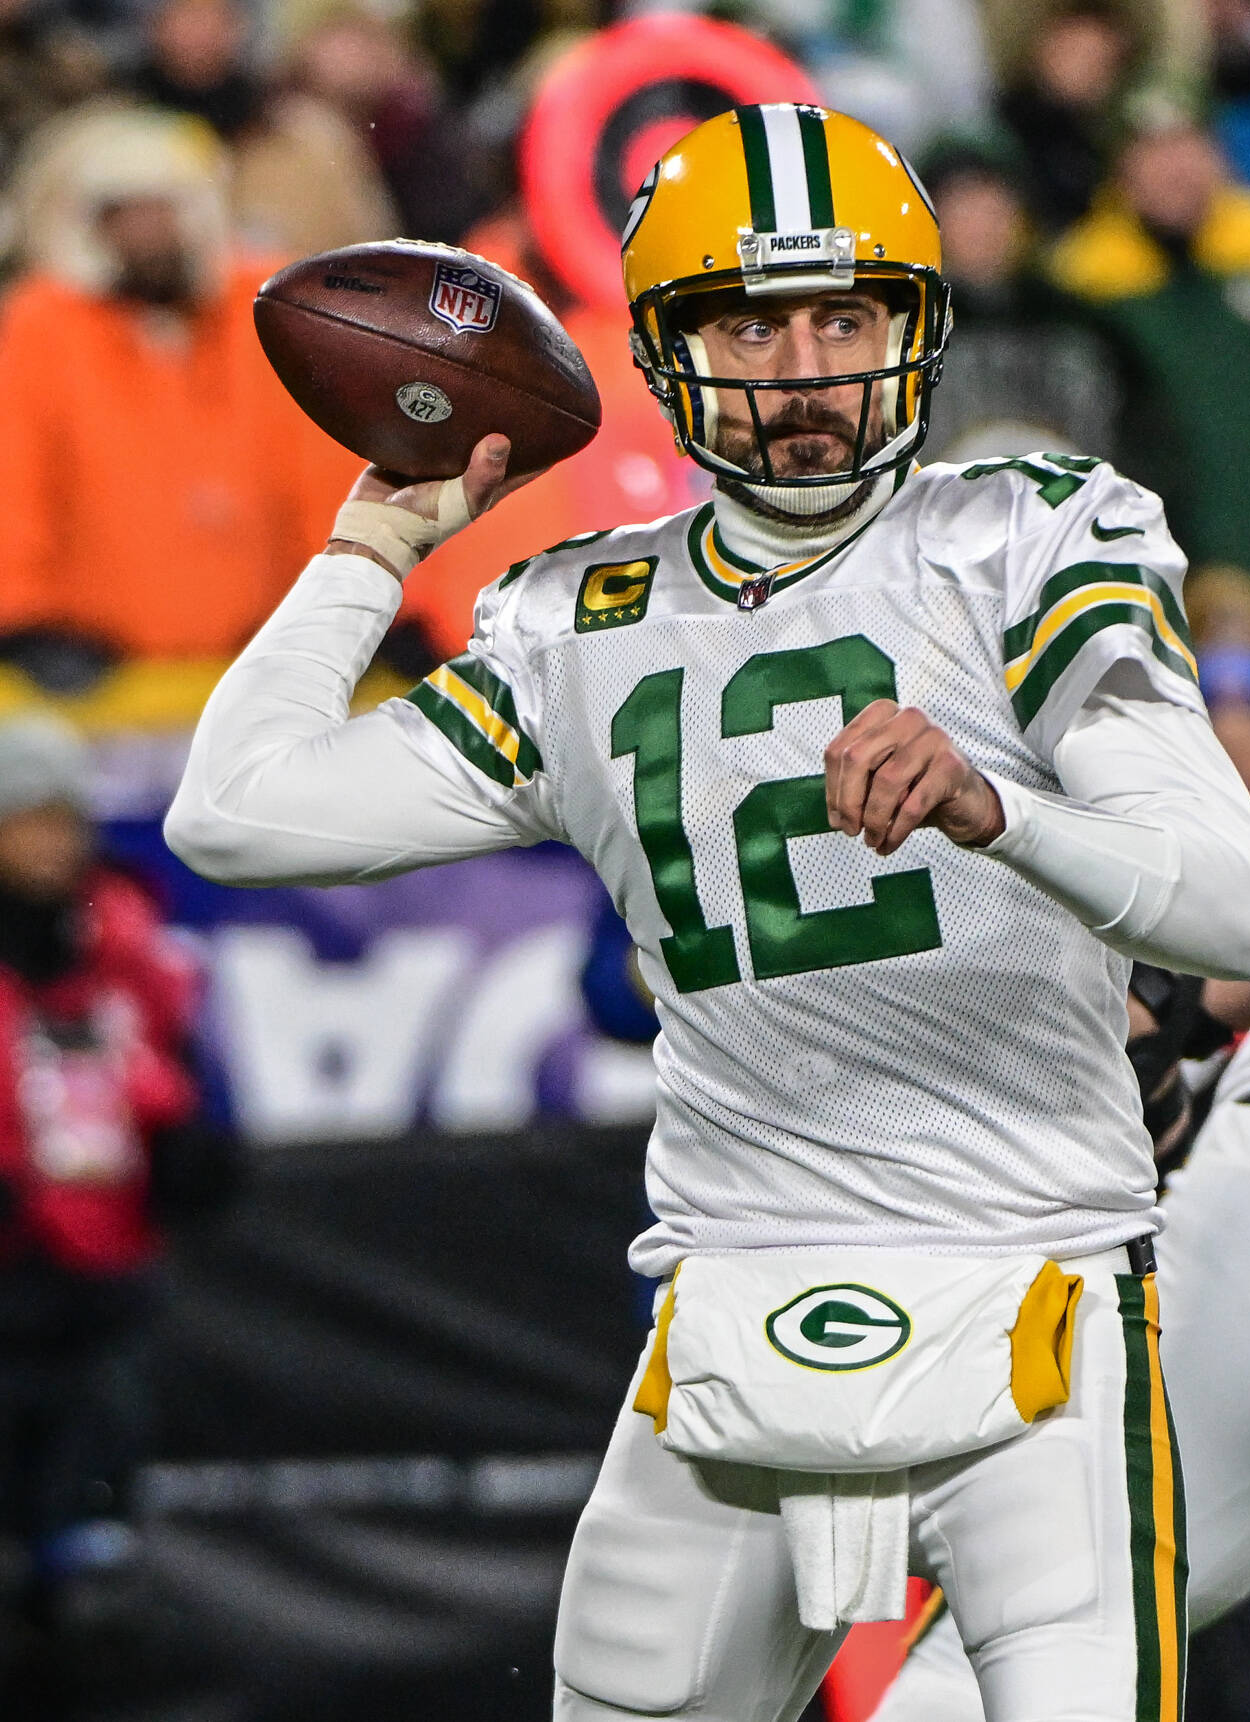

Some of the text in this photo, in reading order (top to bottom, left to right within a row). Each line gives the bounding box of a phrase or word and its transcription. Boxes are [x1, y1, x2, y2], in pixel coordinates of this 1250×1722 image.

[770, 235, 820, 251] PACKERS
[437, 283, 489, 326] NFL
[408, 399, 437, 420] 427
[583, 561, 651, 611] C
[611, 633, 943, 993] 12
